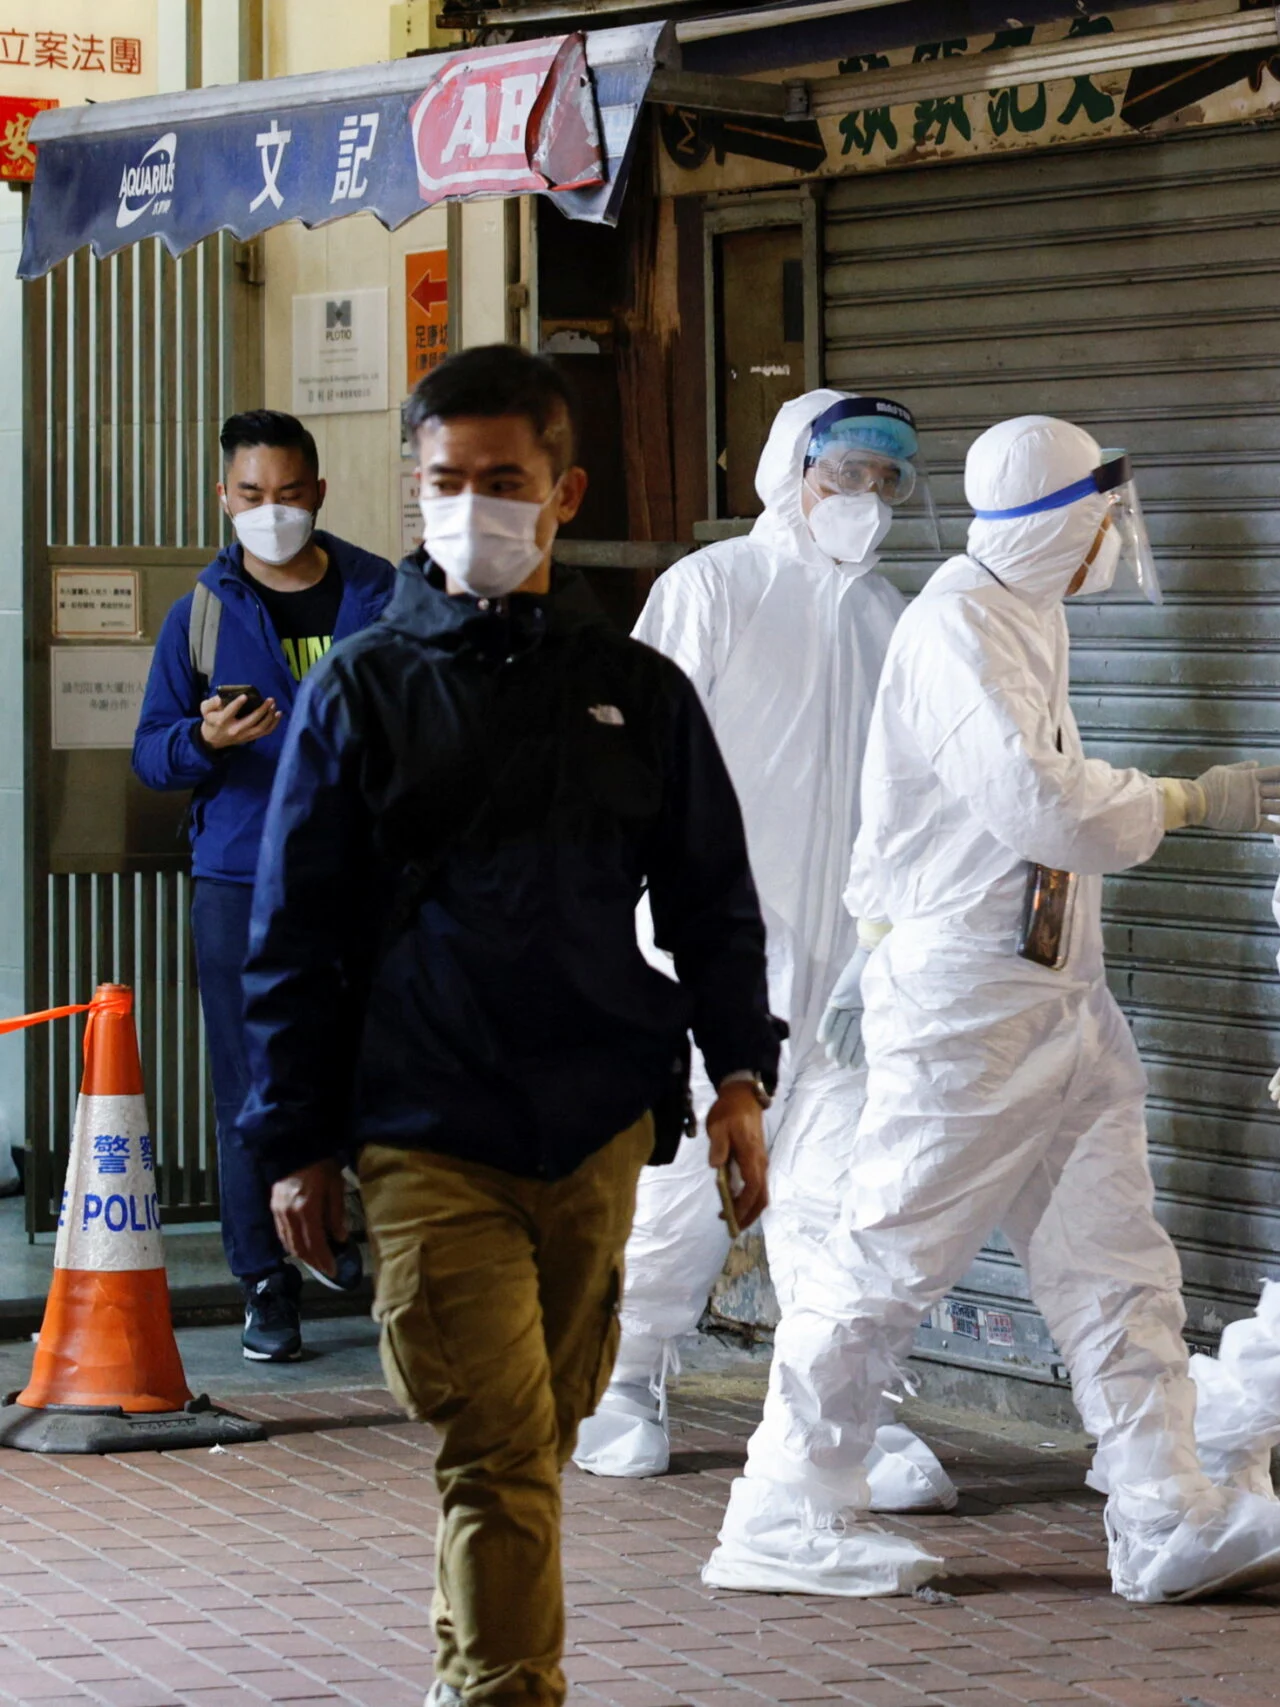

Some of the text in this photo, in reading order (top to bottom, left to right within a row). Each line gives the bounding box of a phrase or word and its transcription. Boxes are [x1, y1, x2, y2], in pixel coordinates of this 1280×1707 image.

[0, 28, 142, 75] 立案法團
[440, 70, 550, 165] AB
